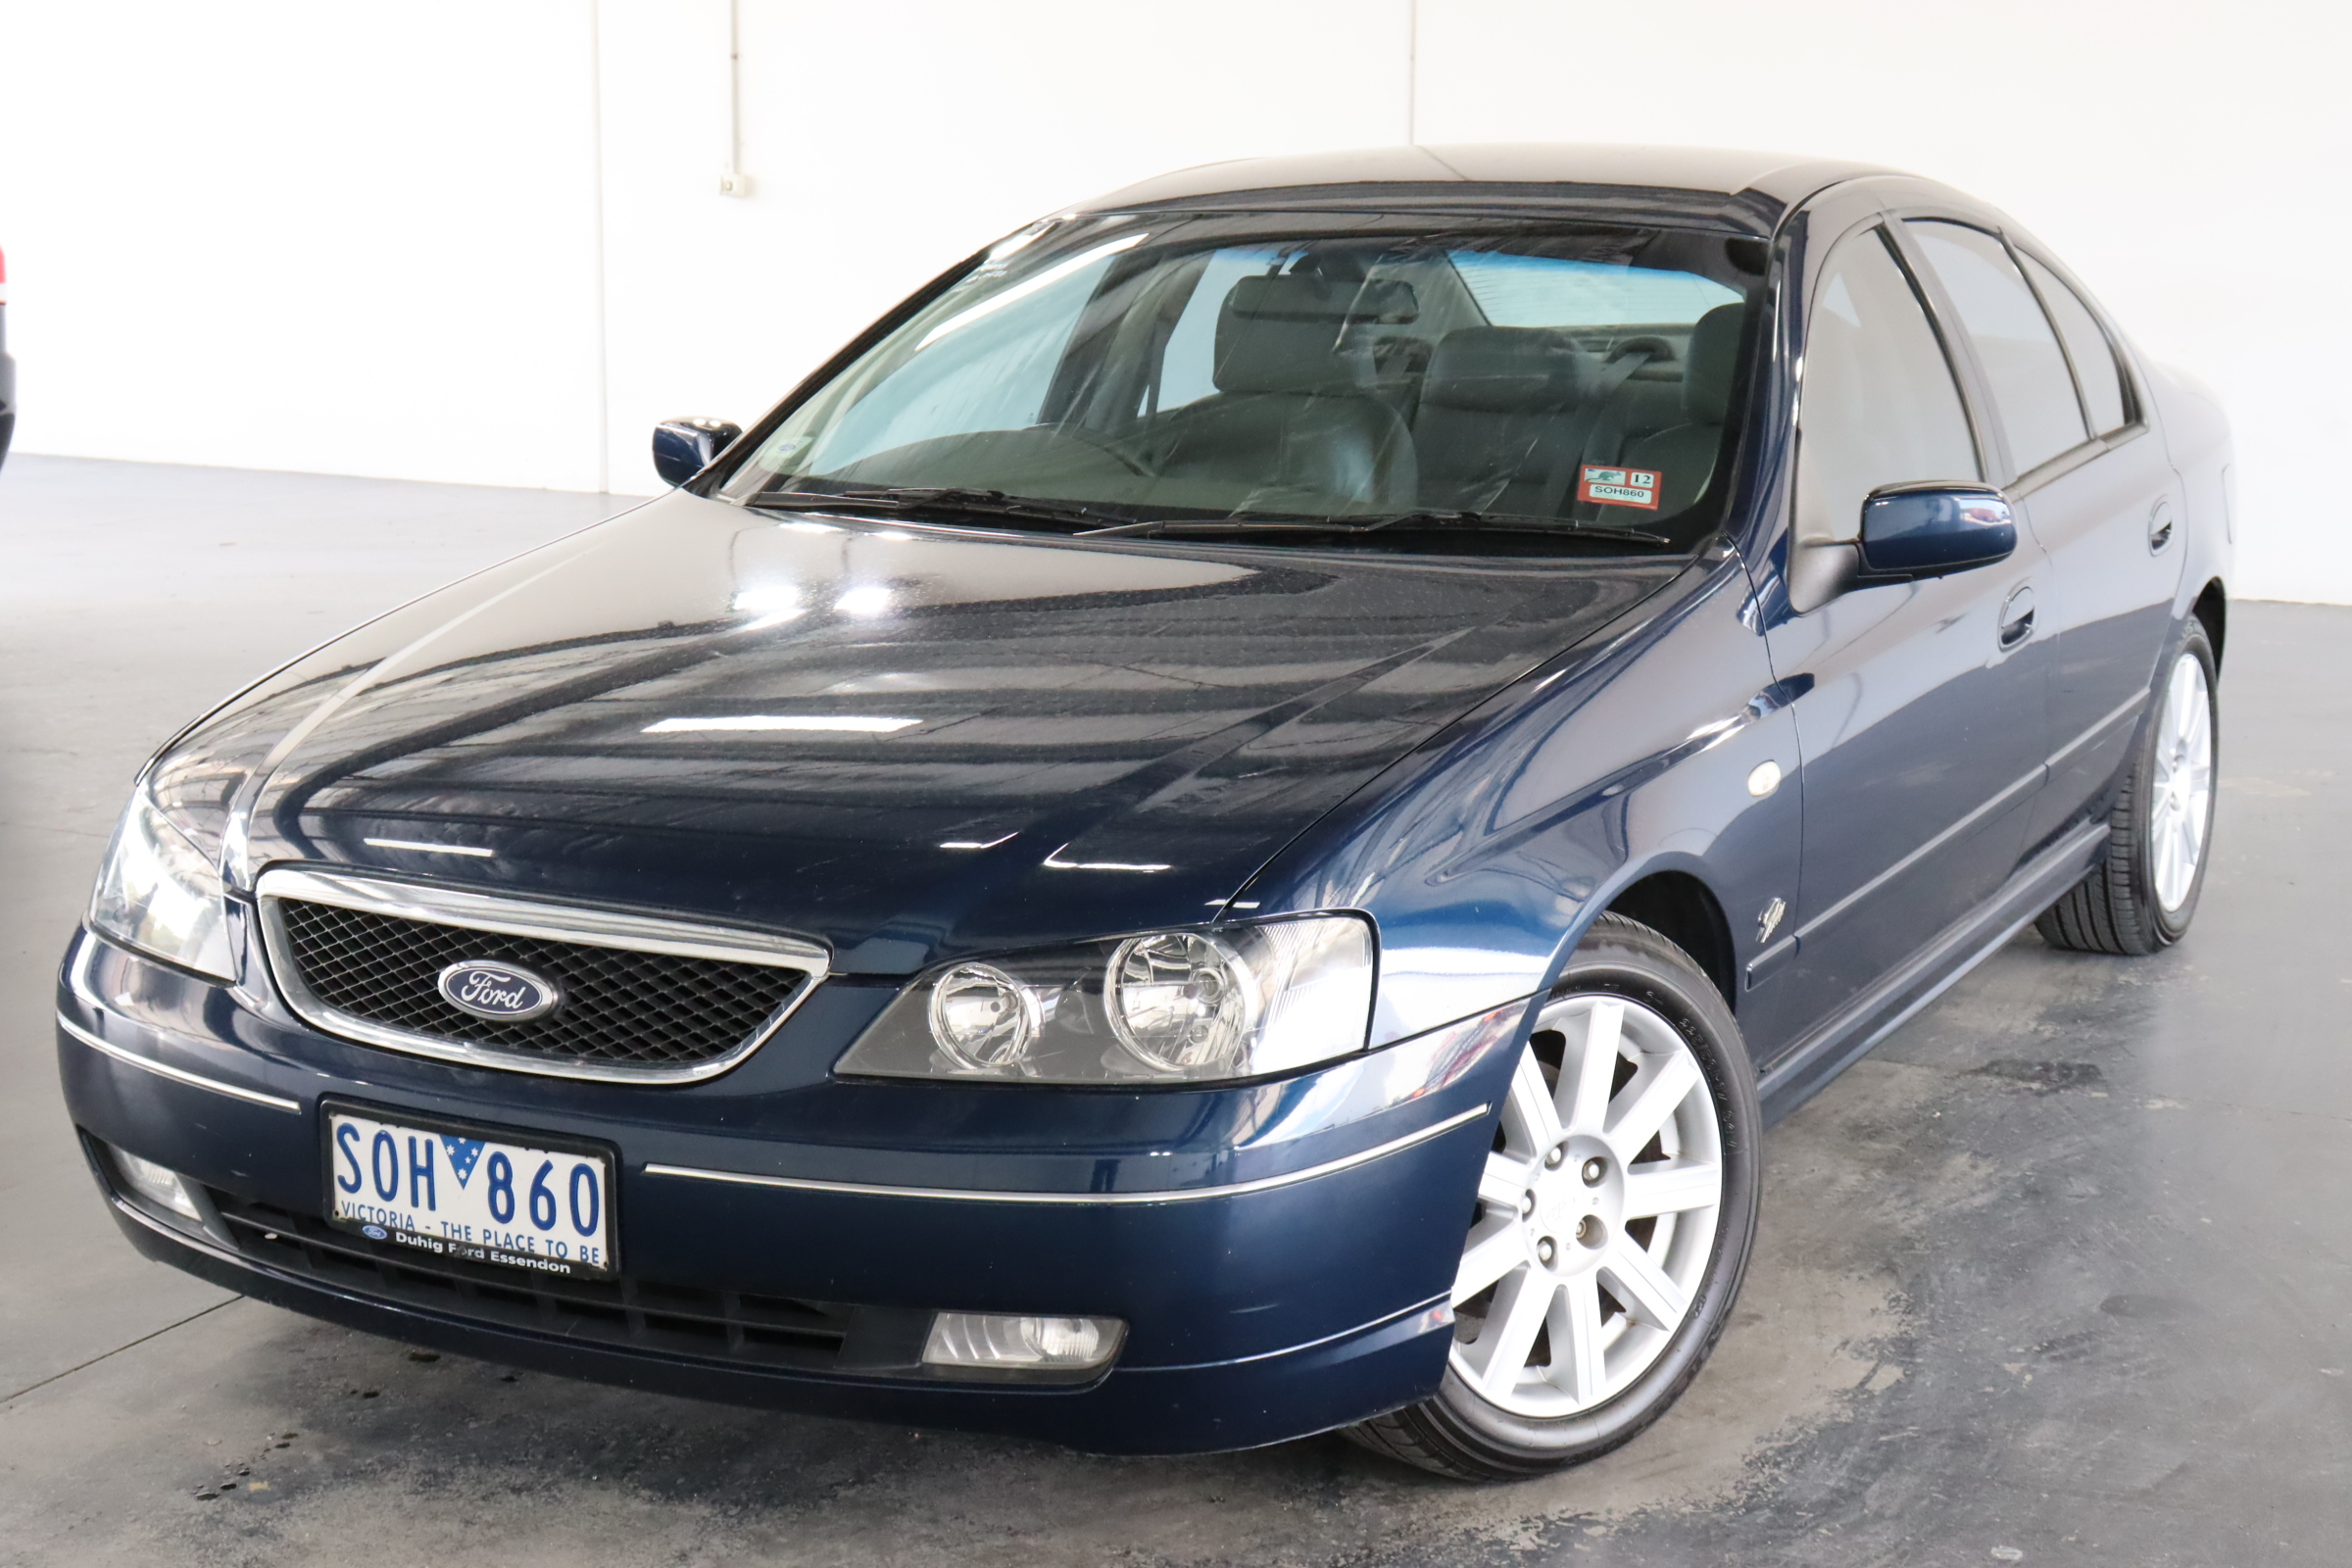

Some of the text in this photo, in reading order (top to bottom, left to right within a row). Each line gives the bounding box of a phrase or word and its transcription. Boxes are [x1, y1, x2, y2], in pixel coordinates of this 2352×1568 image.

[1594, 486, 1644, 498] SOH860
[1634, 473, 1651, 484] 12
[461, 970, 526, 1009] Ford
[336, 1123, 600, 1238] SOH 860
[341, 1200, 416, 1232] VICTORIA
[440, 1221, 472, 1242] THE
[483, 1229, 535, 1253] PLACE
[545, 1240, 568, 1259] TO
[580, 1246, 600, 1264] BE
[395, 1231, 443, 1252] Duhig
[491, 1251, 571, 1274] Essendon
